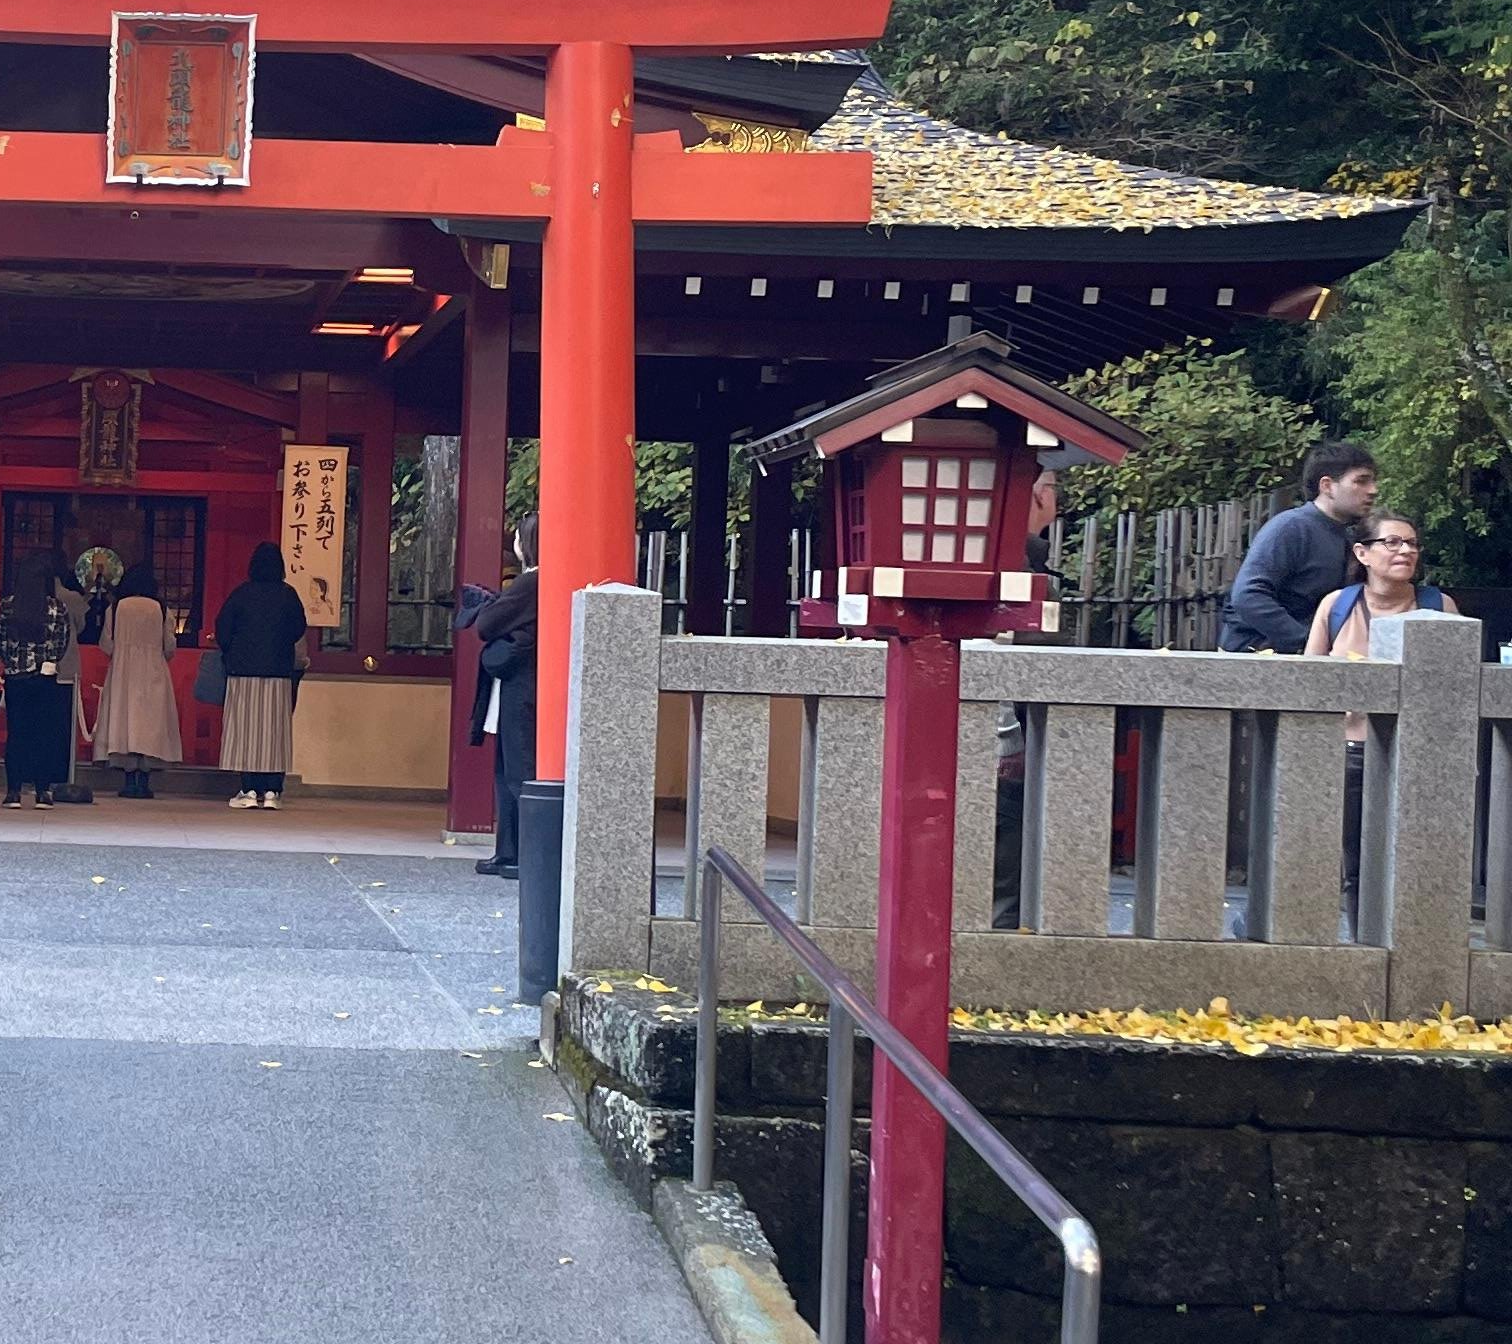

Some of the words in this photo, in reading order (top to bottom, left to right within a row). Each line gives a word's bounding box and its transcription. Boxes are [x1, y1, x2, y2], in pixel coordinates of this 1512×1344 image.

[289, 460, 311, 574] お参り下さい
